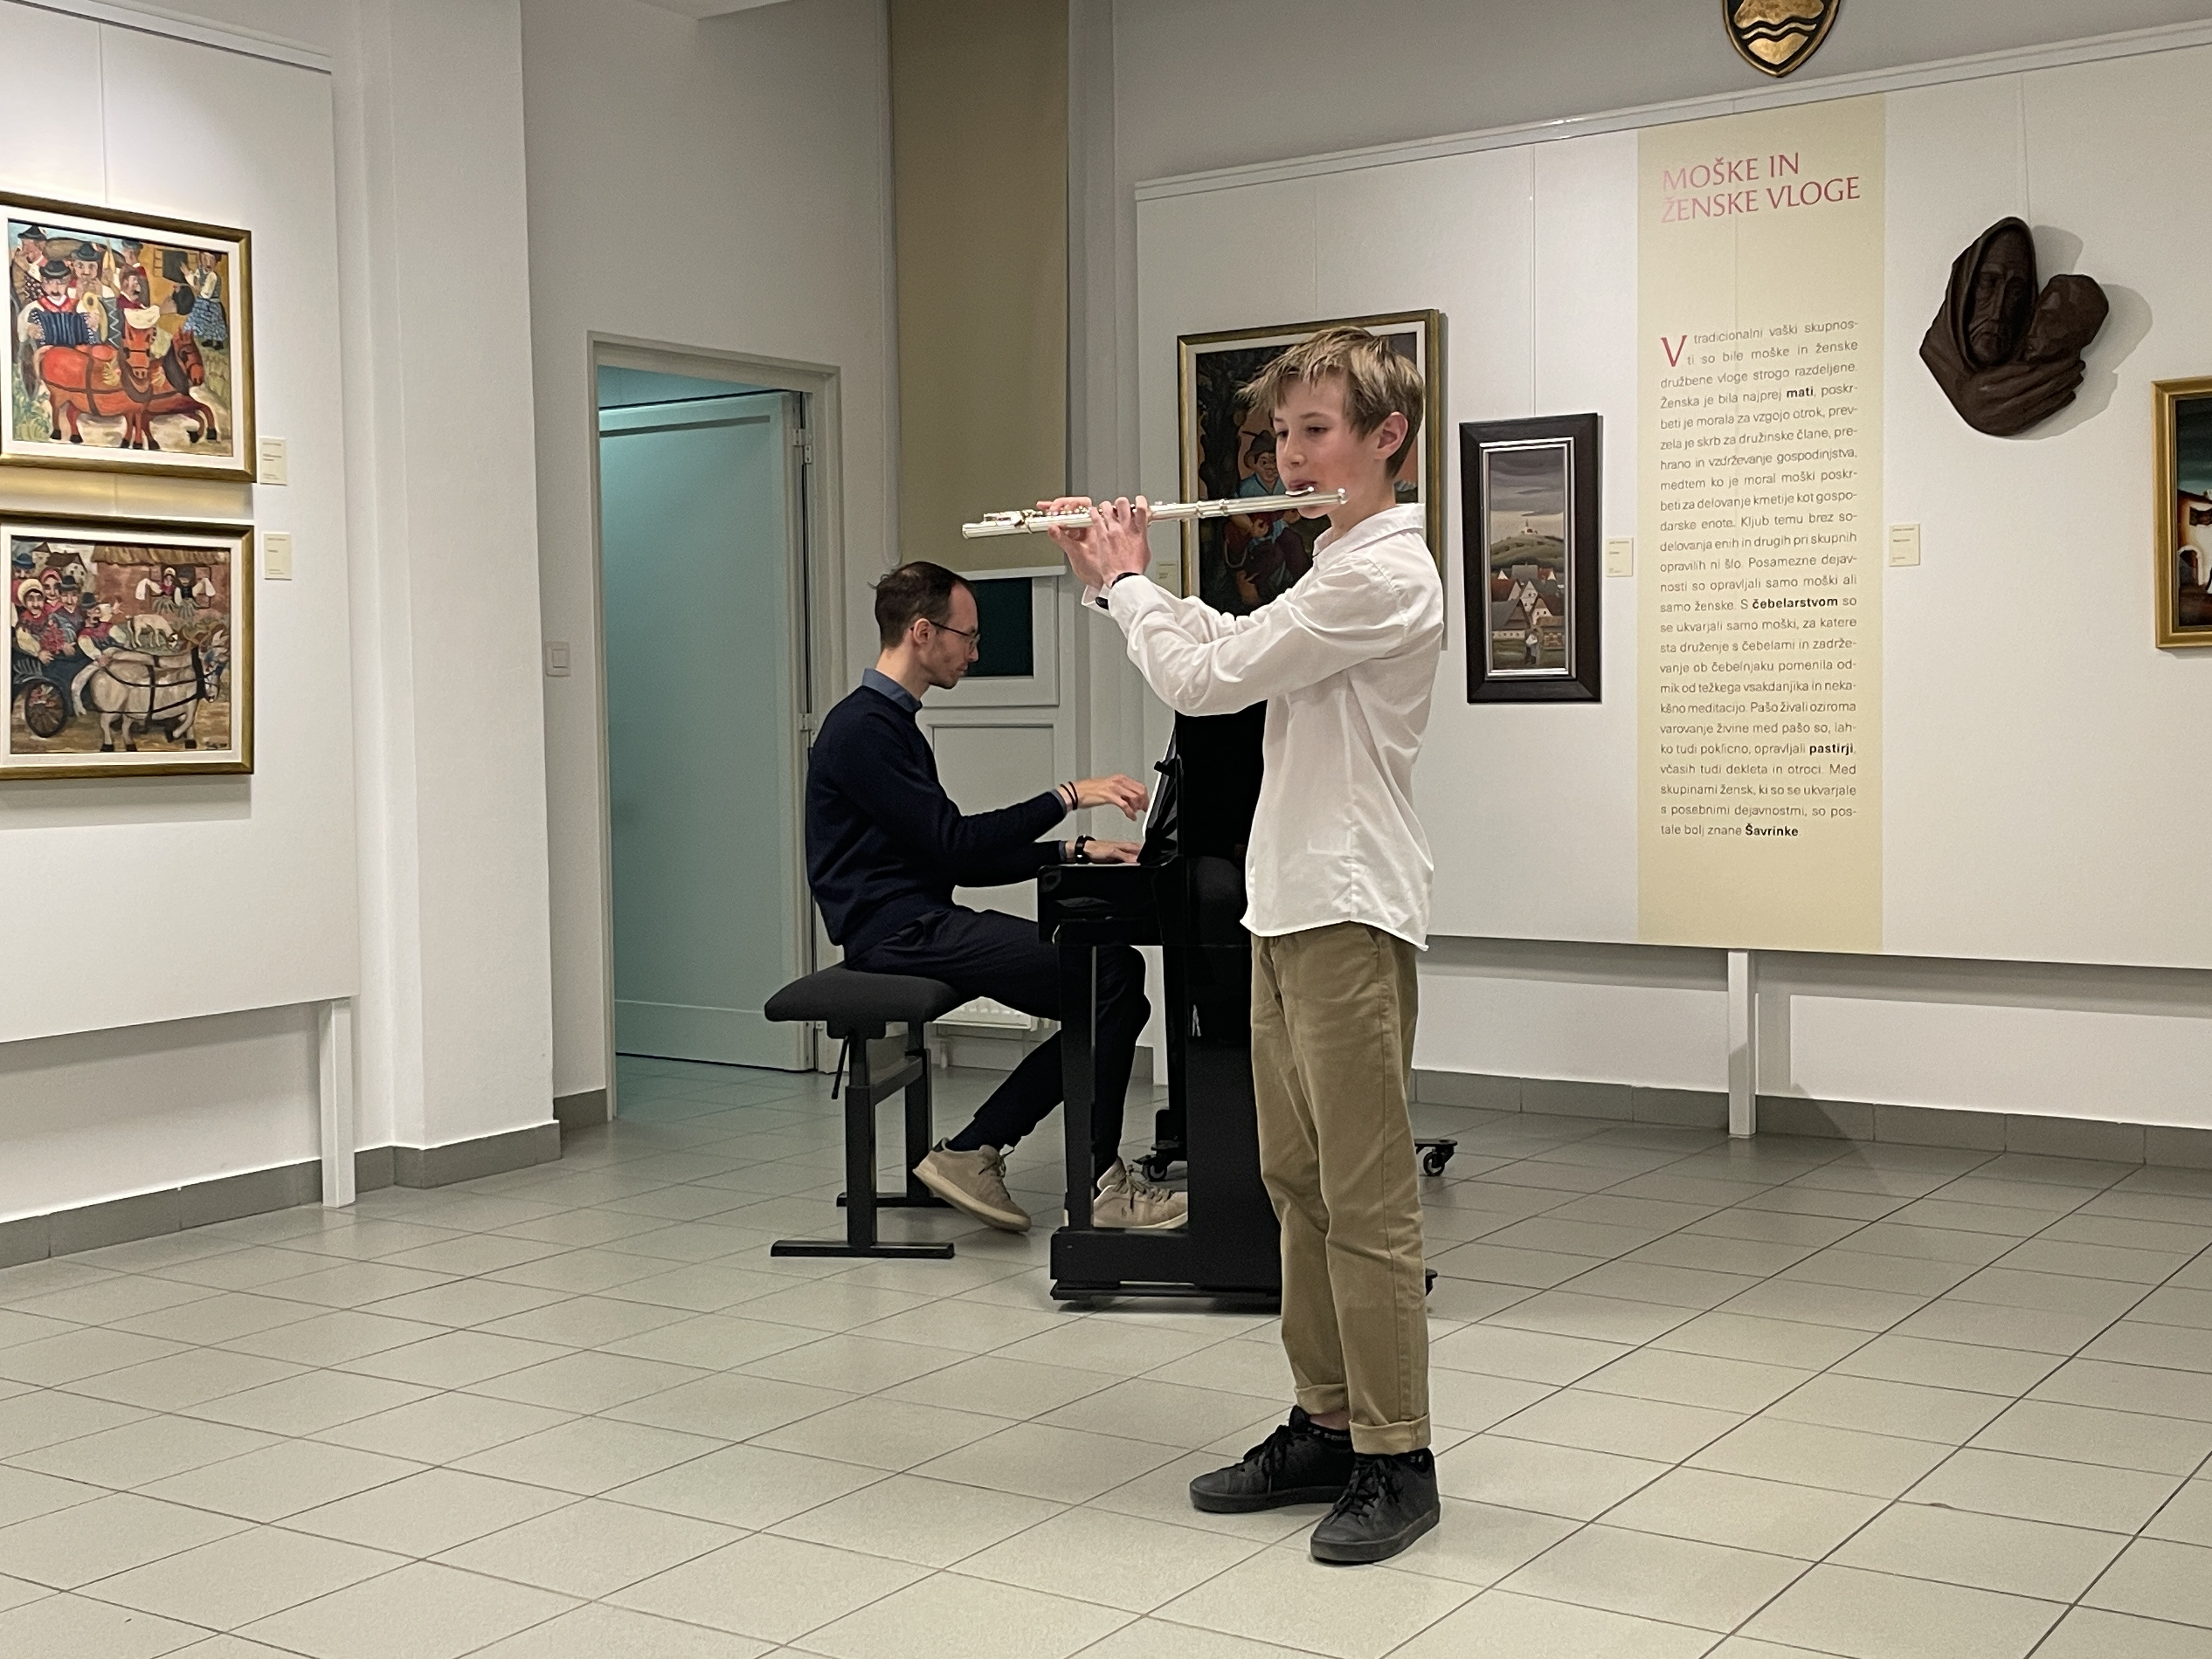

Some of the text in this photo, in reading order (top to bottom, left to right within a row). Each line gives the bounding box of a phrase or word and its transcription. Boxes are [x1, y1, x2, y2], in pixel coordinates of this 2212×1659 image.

[1663, 151, 1798, 190] MOŠKE IN
[1661, 176, 1860, 223] ŽENSKE VLOGE
[1660, 321, 1859, 367] V tradicionalni vaški skupnos-
[1687, 340, 1858, 365] ti so bile moške in ženske
[1661, 376, 1713, 388] družbene
[1718, 373, 1747, 385] vloge
[1753, 370, 1790, 381] strogo
[1660, 396, 1699, 409] Ženska
[1703, 397, 1714, 408] je
[1718, 393, 1738, 404] bila
[1743, 388, 1781, 403] najprej
[1821, 383, 1858, 398] poskr-
[1661, 407, 1858, 430] beti je morala za vzgojo otrok, prev-
[1661, 428, 1858, 450] zela je skrb za družinske člane, pre-
[1661, 460, 1691, 470] hrano
[1695, 457, 1705, 467] in
[1708, 455, 1773, 466] vzdrževanje
[1661, 469, 1858, 490] medtem ko je moral moški poskr-
[1661, 492, 1857, 511] beti za delovanje kmetije kot gospo-
[1660, 520, 1696, 531] darske
[1741, 515, 1769, 529] Kljub
[1774, 516, 1803, 525] temu
[1808, 513, 1834, 523] brez
[1839, 513, 1858, 522] so-
[1660, 532, 1857, 552] delovanja enih in drugih pri skupnih
[1660, 560, 1706, 574] opravilih
[1711, 558, 1720, 569] ni
[1749, 557, 1816, 568] Posamezne
[1821, 554, 1857, 567] dejav-
[1661, 581, 1687, 592] nosti
[1710, 578, 1760, 592] opravljali
[1765, 579, 1798, 588] samo
[1803, 574, 1838, 586] moški
[1843, 574, 1857, 585] ali
[1660, 604, 1691, 612] samo
[1740, 599, 1748, 610] S
[1752, 597, 1838, 609] čebelarstvom
[1843, 597, 1857, 606] so
[1677, 620, 1722, 634] ukvarjali
[1726, 621, 1758, 630] samo
[1762, 618, 1799, 630] moški,
[1802, 619, 1815, 628] za
[1820, 617, 1857, 628] katere
[1660, 637, 1857, 654] sta druženje s čebelami in zadrže-
[1660, 658, 1857, 675] vanje ob čebelnjaku pomenila od-
[1661, 680, 1857, 695] mik od težkega vsakdanjika in neka-
[1661, 703, 1686, 714] kšno
[1751, 702, 1778, 712] Pašo
[1780, 701, 1808, 712] živali
[1810, 703, 1856, 712] oziroma
[1660, 722, 1857, 736] varovanje živine med pašo so, lah-
[1661, 743, 1673, 754] ko
[1677, 744, 1697, 754] tudi
[1701, 743, 1751, 755] poklicno,
[1754, 743, 1805, 755] opravljali
[1660, 764, 1695, 774] včasih
[1701, 764, 1721, 774] tudi
[1726, 764, 1768, 774] dekleta
[1773, 765, 1782, 774] in
[1830, 764, 1856, 775] Med
[1661, 784, 1717, 796] skupinami
[1759, 784, 1768, 794] ki
[1771, 787, 1784, 795] so
[1787, 787, 1801, 795] se
[1804, 785, 1857, 798] ukvarjale
[1671, 804, 1729, 816] posebnimi
[1735, 804, 1807, 817] dejavnostmi,
[1812, 808, 1826, 816] so
[1831, 808, 1857, 818] pos-
[1661, 824, 1681, 834] tale
[1684, 824, 1704, 837] bolj
[1708, 827, 1742, 836] znane
